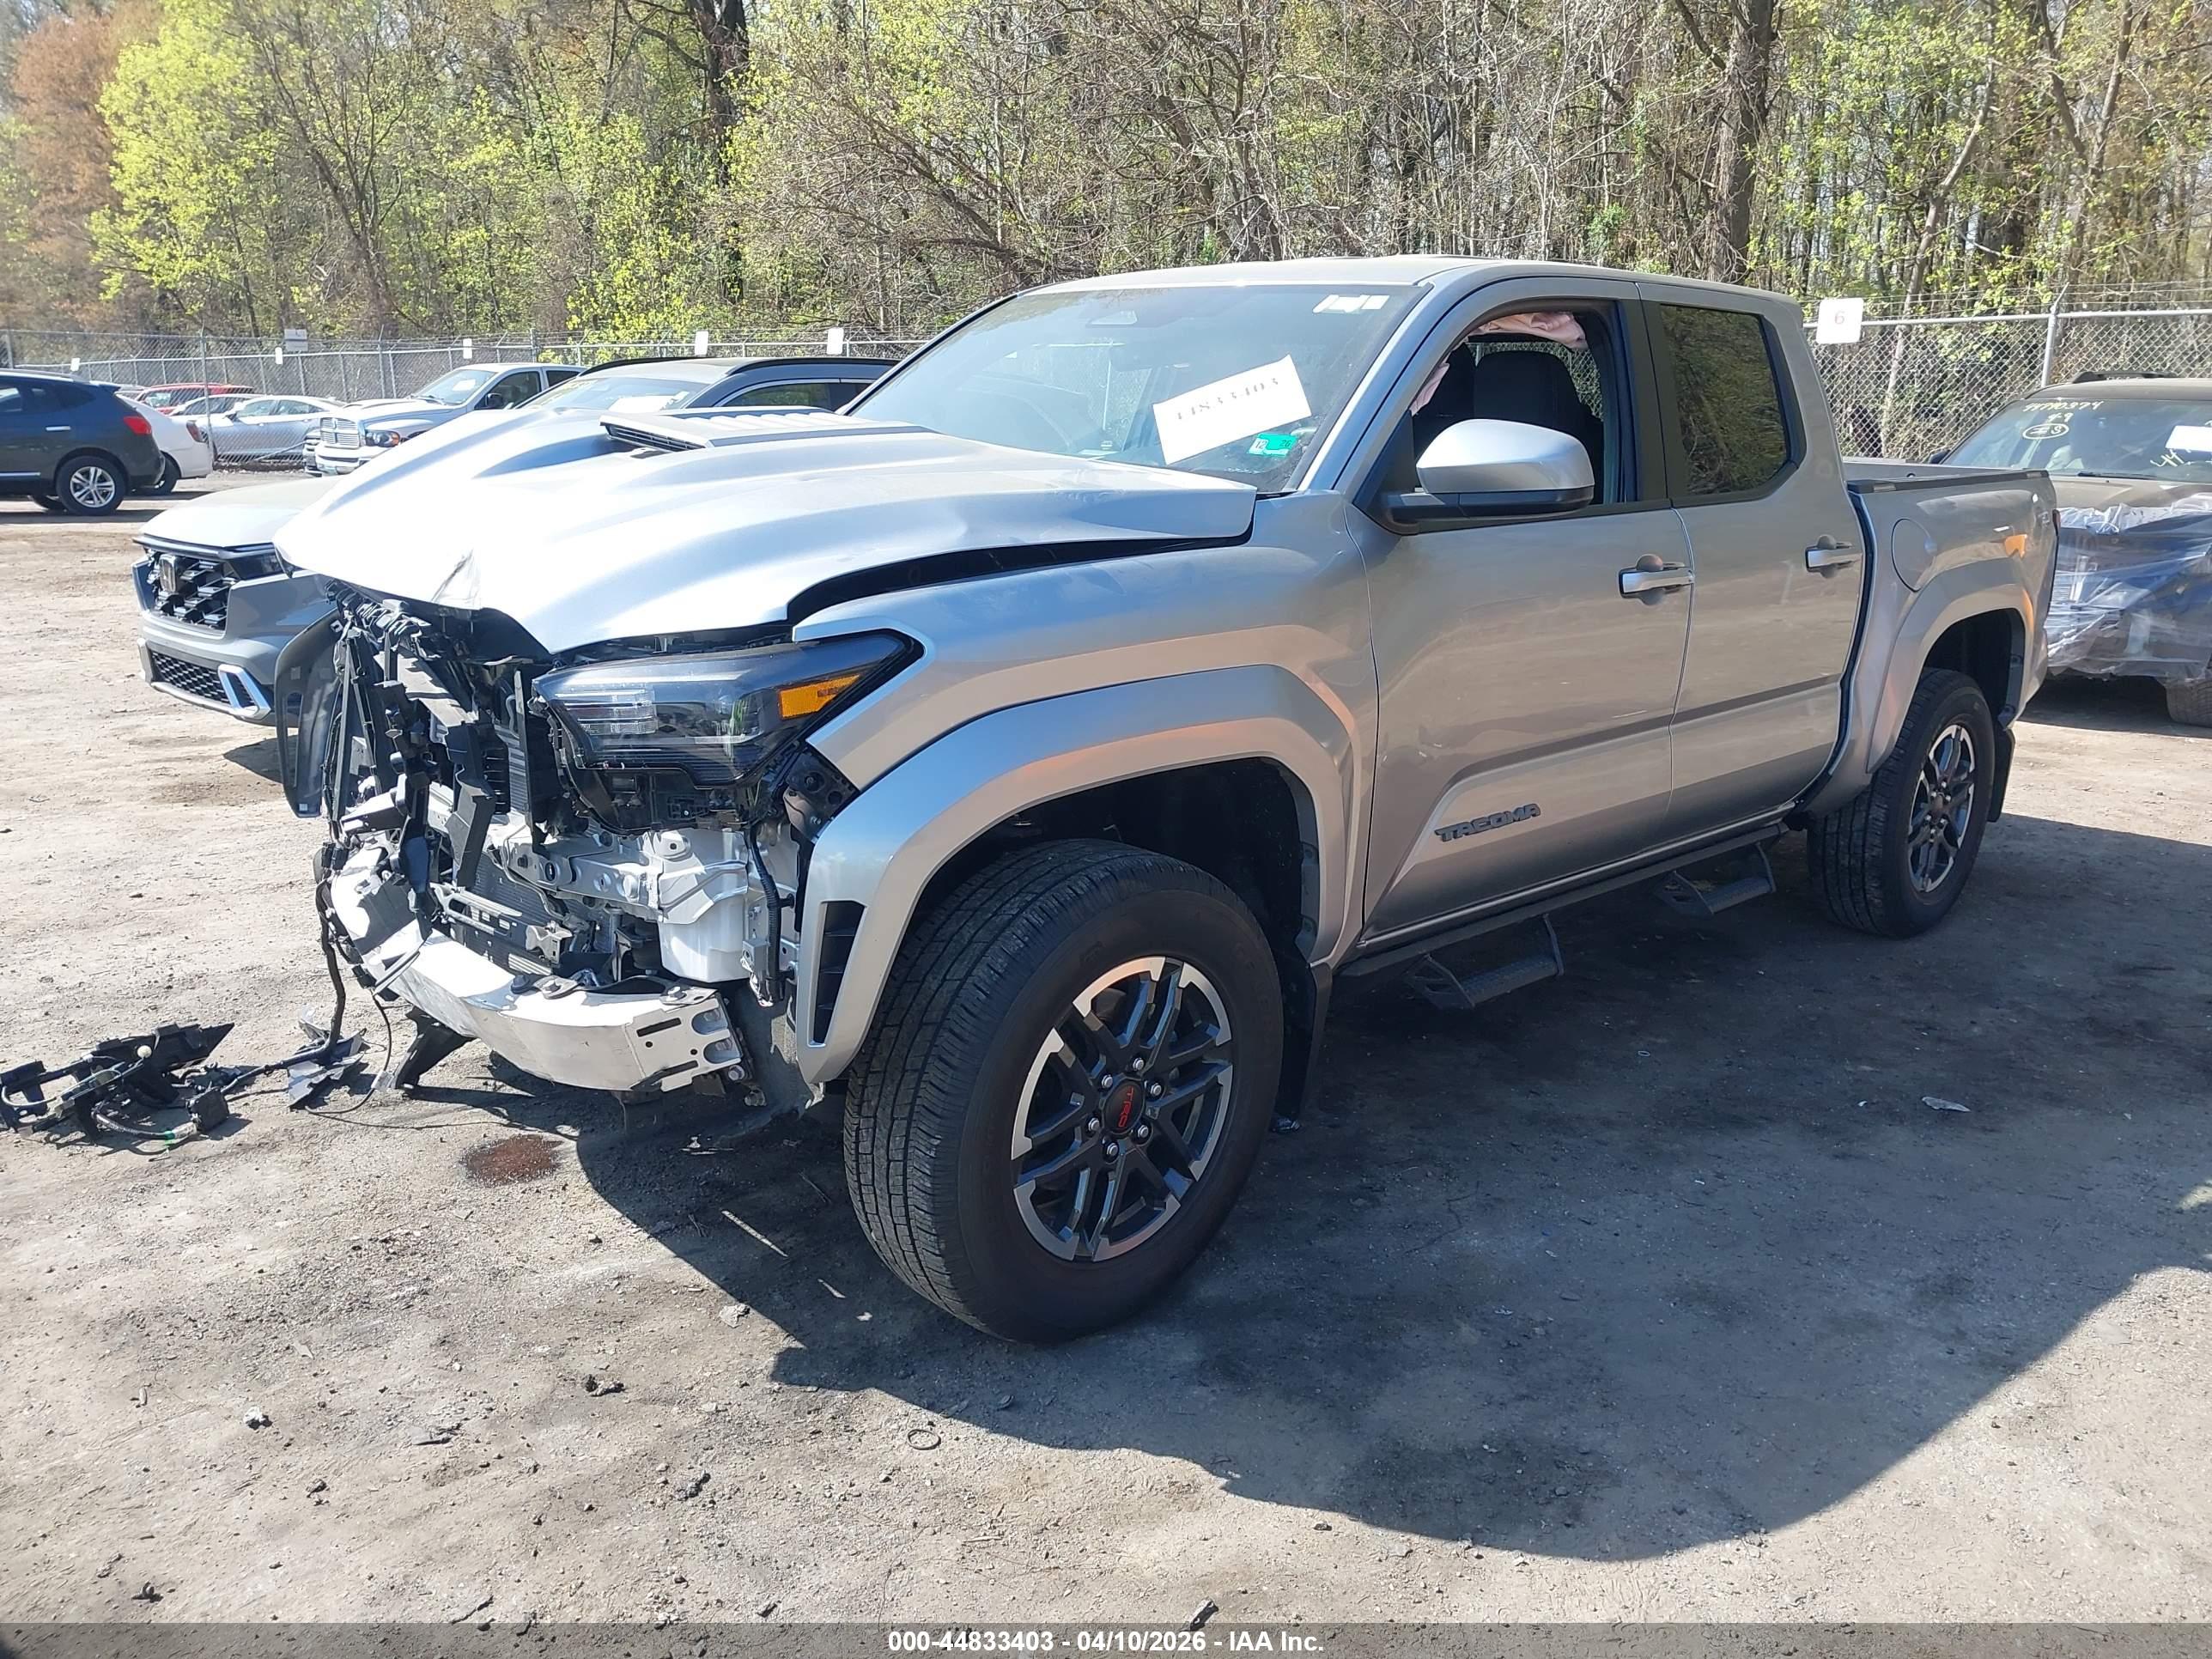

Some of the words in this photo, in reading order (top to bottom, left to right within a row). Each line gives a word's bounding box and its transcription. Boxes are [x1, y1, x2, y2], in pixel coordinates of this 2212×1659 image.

[1834, 310, 1845, 325] 6
[1255, 440, 1267, 449] 12
[1434, 803, 1541, 842] TACOMA
[1118, 1085, 1133, 1127] TRD
